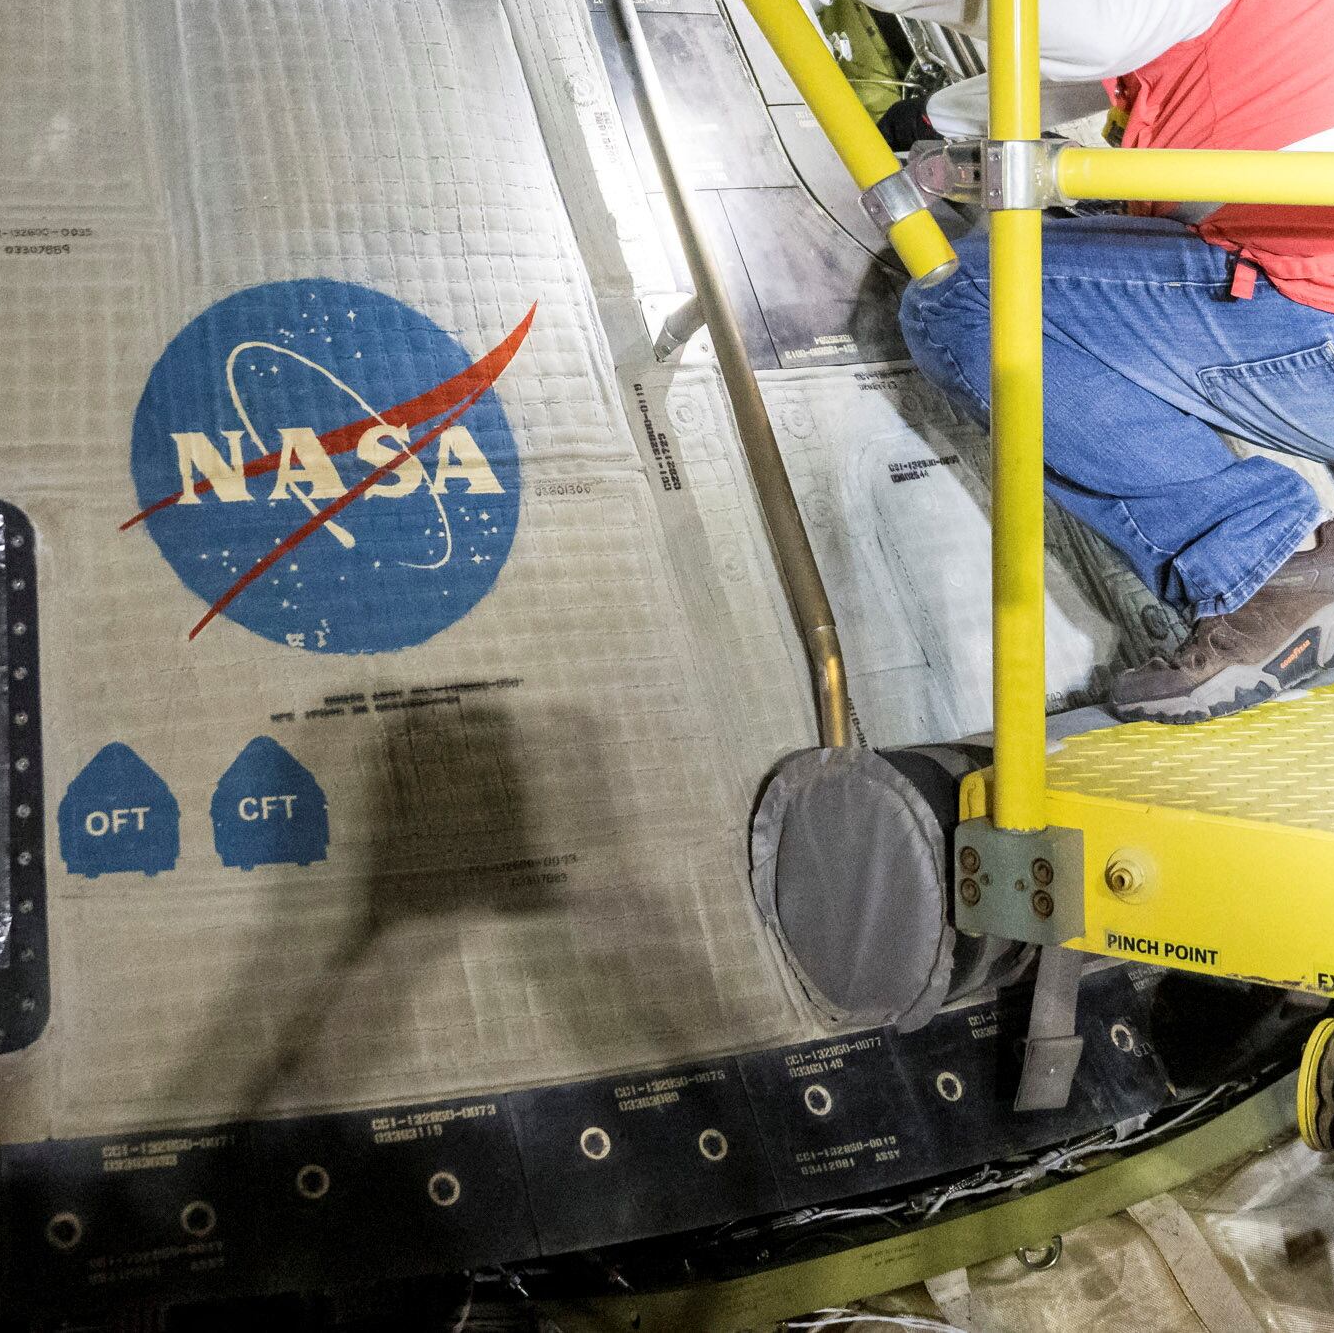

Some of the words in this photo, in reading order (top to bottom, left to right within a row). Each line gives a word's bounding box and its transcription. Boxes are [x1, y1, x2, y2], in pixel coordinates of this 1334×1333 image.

[170, 422, 507, 505] NASA
[85, 806, 151, 837] OFT
[238, 794, 298, 822] CFT
[1107, 933, 1159, 956] PINCH
[1164, 942, 1219, 966] POINT
